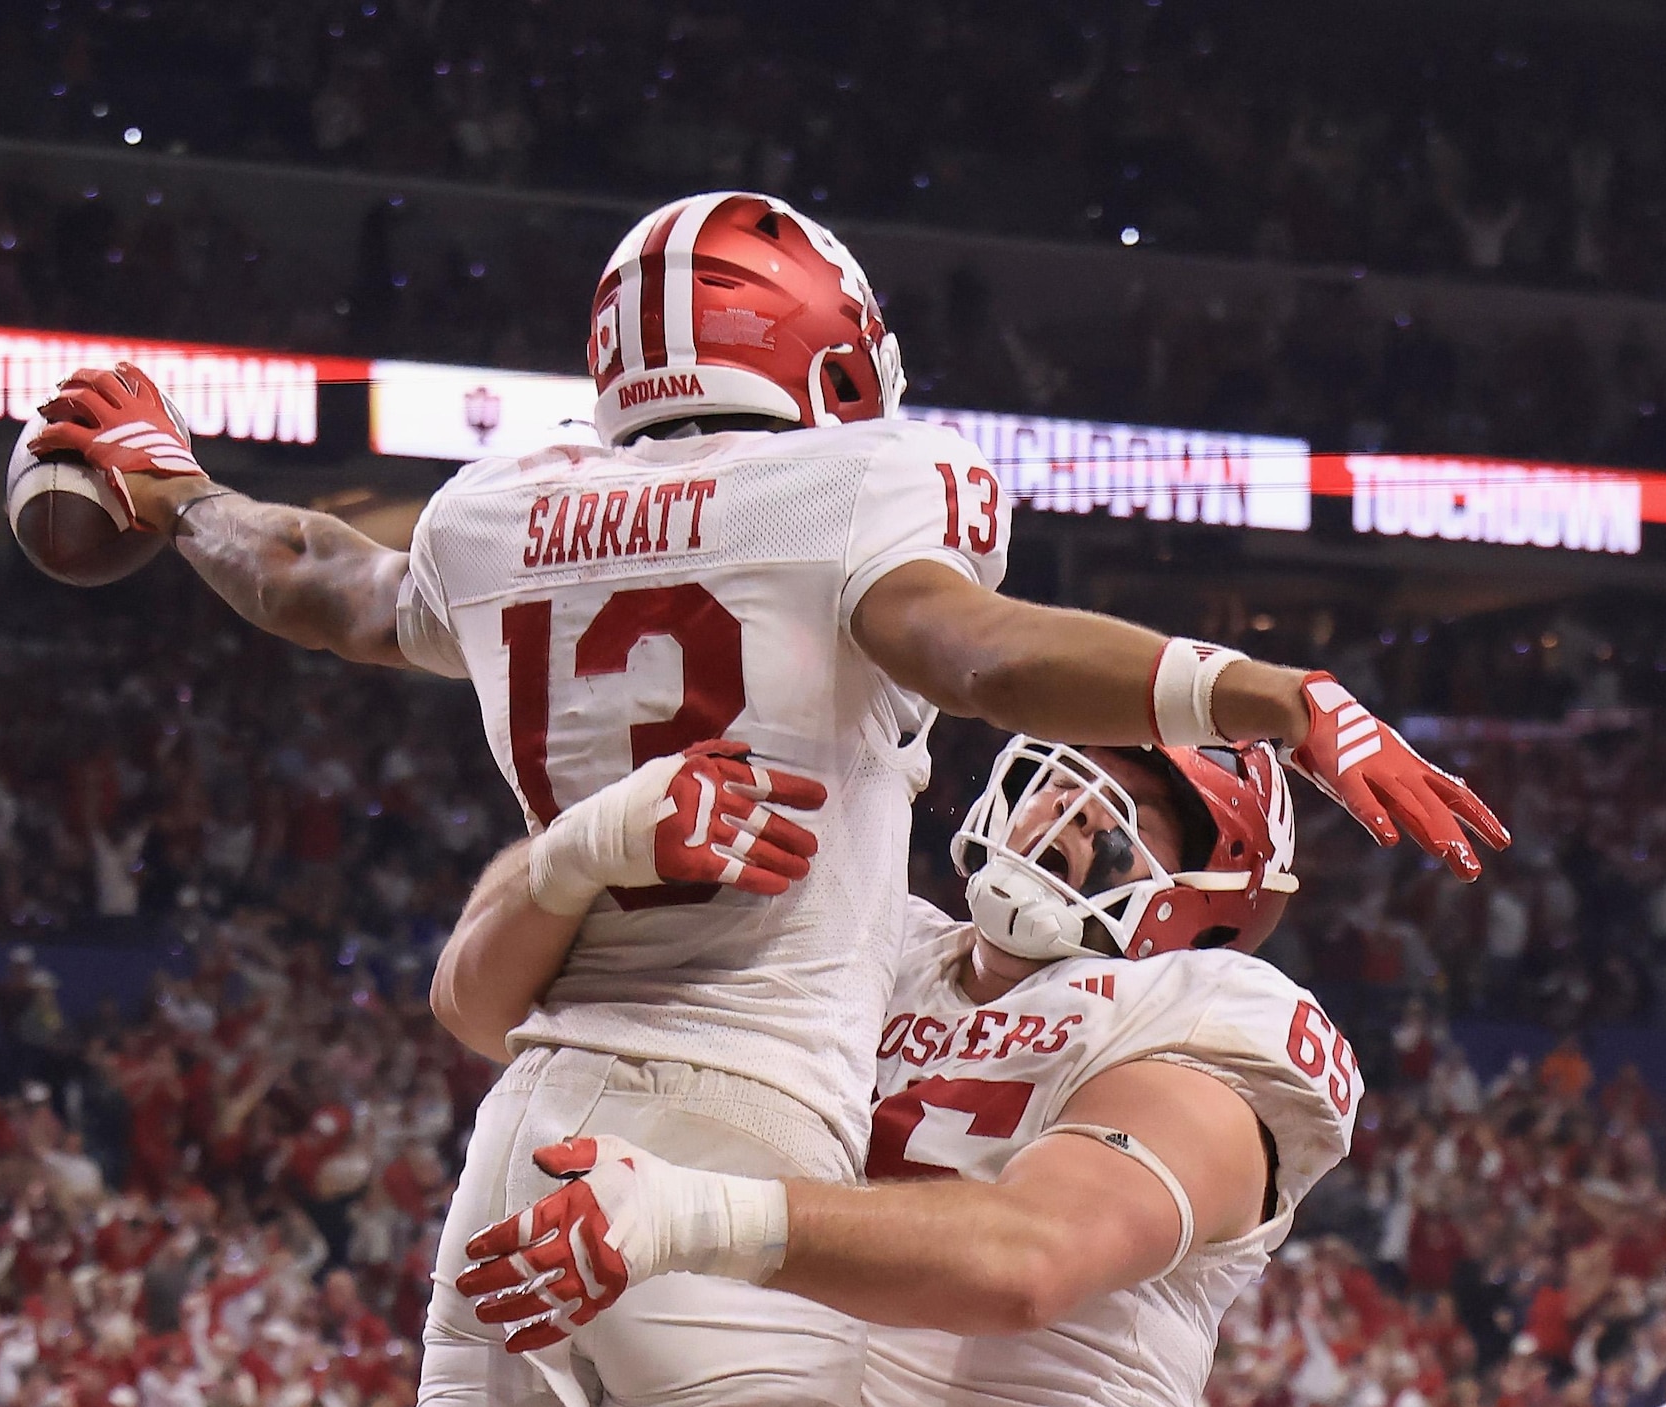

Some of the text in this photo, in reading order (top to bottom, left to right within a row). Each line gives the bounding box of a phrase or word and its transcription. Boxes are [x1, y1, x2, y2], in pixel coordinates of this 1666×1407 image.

[618, 374, 704, 410] INDIANA
[523, 480, 716, 568] SARRATT
[935, 462, 997, 554] 13
[1345, 455, 1641, 553] TOUCHDOWN
[502, 582, 746, 912] 13
[876, 1010, 1083, 1067] OSIERS
